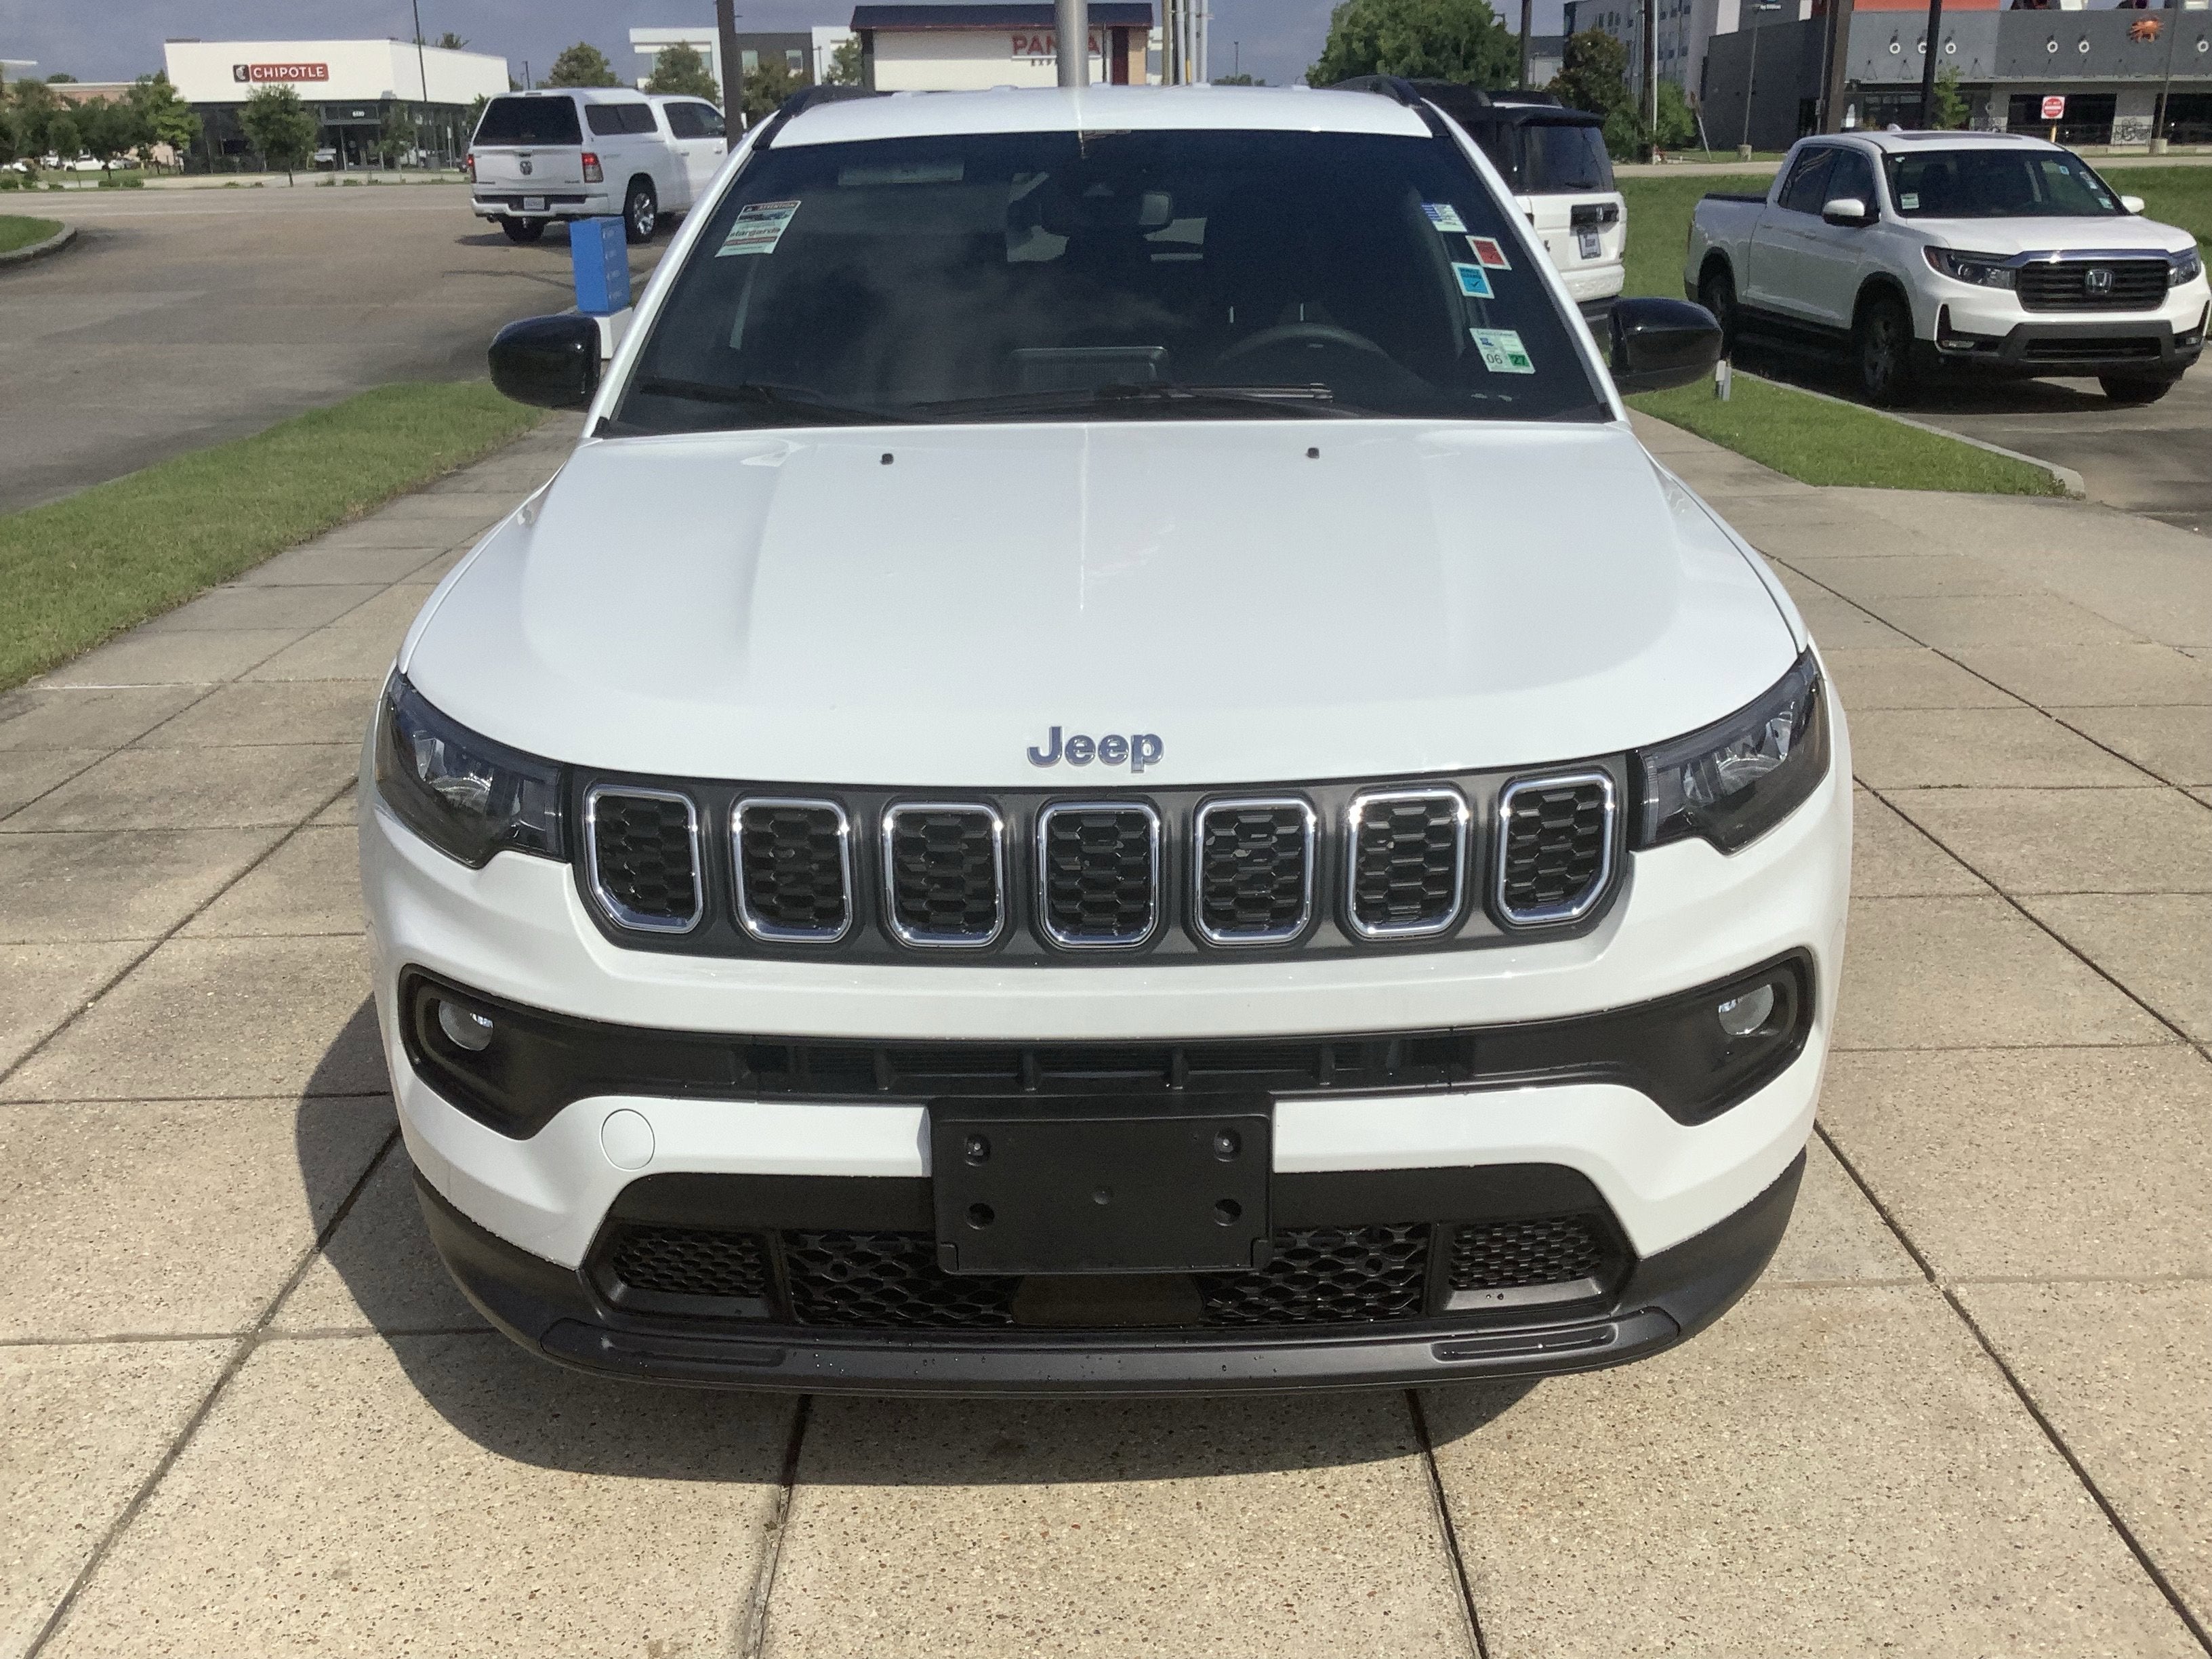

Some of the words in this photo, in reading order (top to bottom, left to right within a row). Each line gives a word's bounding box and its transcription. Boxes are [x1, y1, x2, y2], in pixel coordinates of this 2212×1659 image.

[1012, 35, 1101, 55] PANA
[253, 66, 325, 78] CHIPOTLE
[1486, 353, 1503, 365] 06
[1512, 354, 1527, 365] 27
[1027, 726, 1164, 773] Jeep
